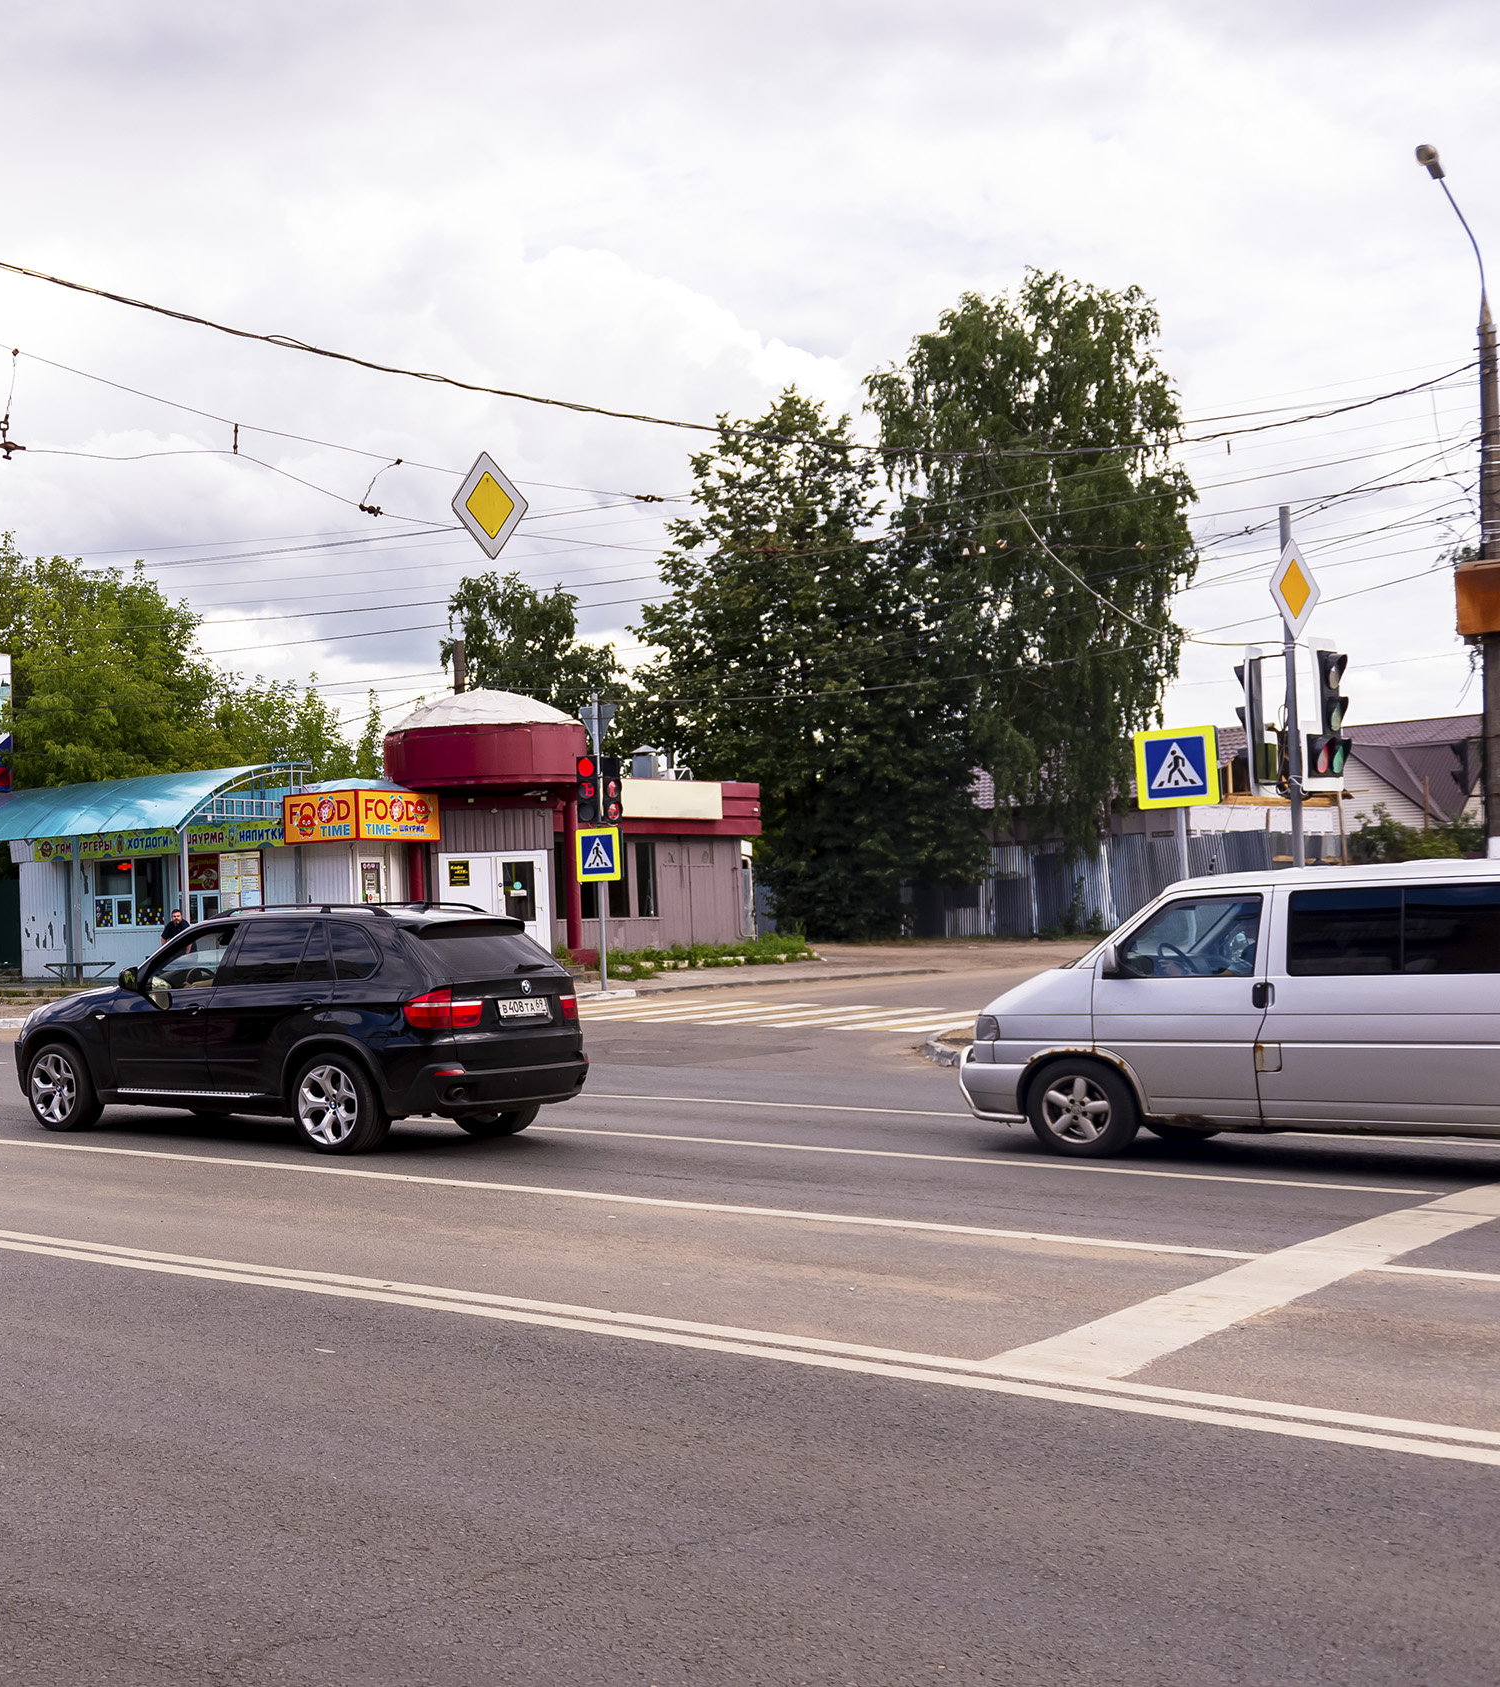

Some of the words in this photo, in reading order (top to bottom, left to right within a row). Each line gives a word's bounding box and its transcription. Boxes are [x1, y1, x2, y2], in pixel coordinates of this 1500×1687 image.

[289, 799, 350, 824] FOOD
[364, 798, 415, 822] FOOD
[320, 824, 350, 837] TIME
[365, 823, 391, 836] TIME
[399, 825, 425, 833] ШАУРМА
[55, 839, 112, 855] ГАМУРГЕРЫ
[127, 835, 169, 851] ХОТДОГИ
[238, 827, 284, 843] НАПИТКИ
